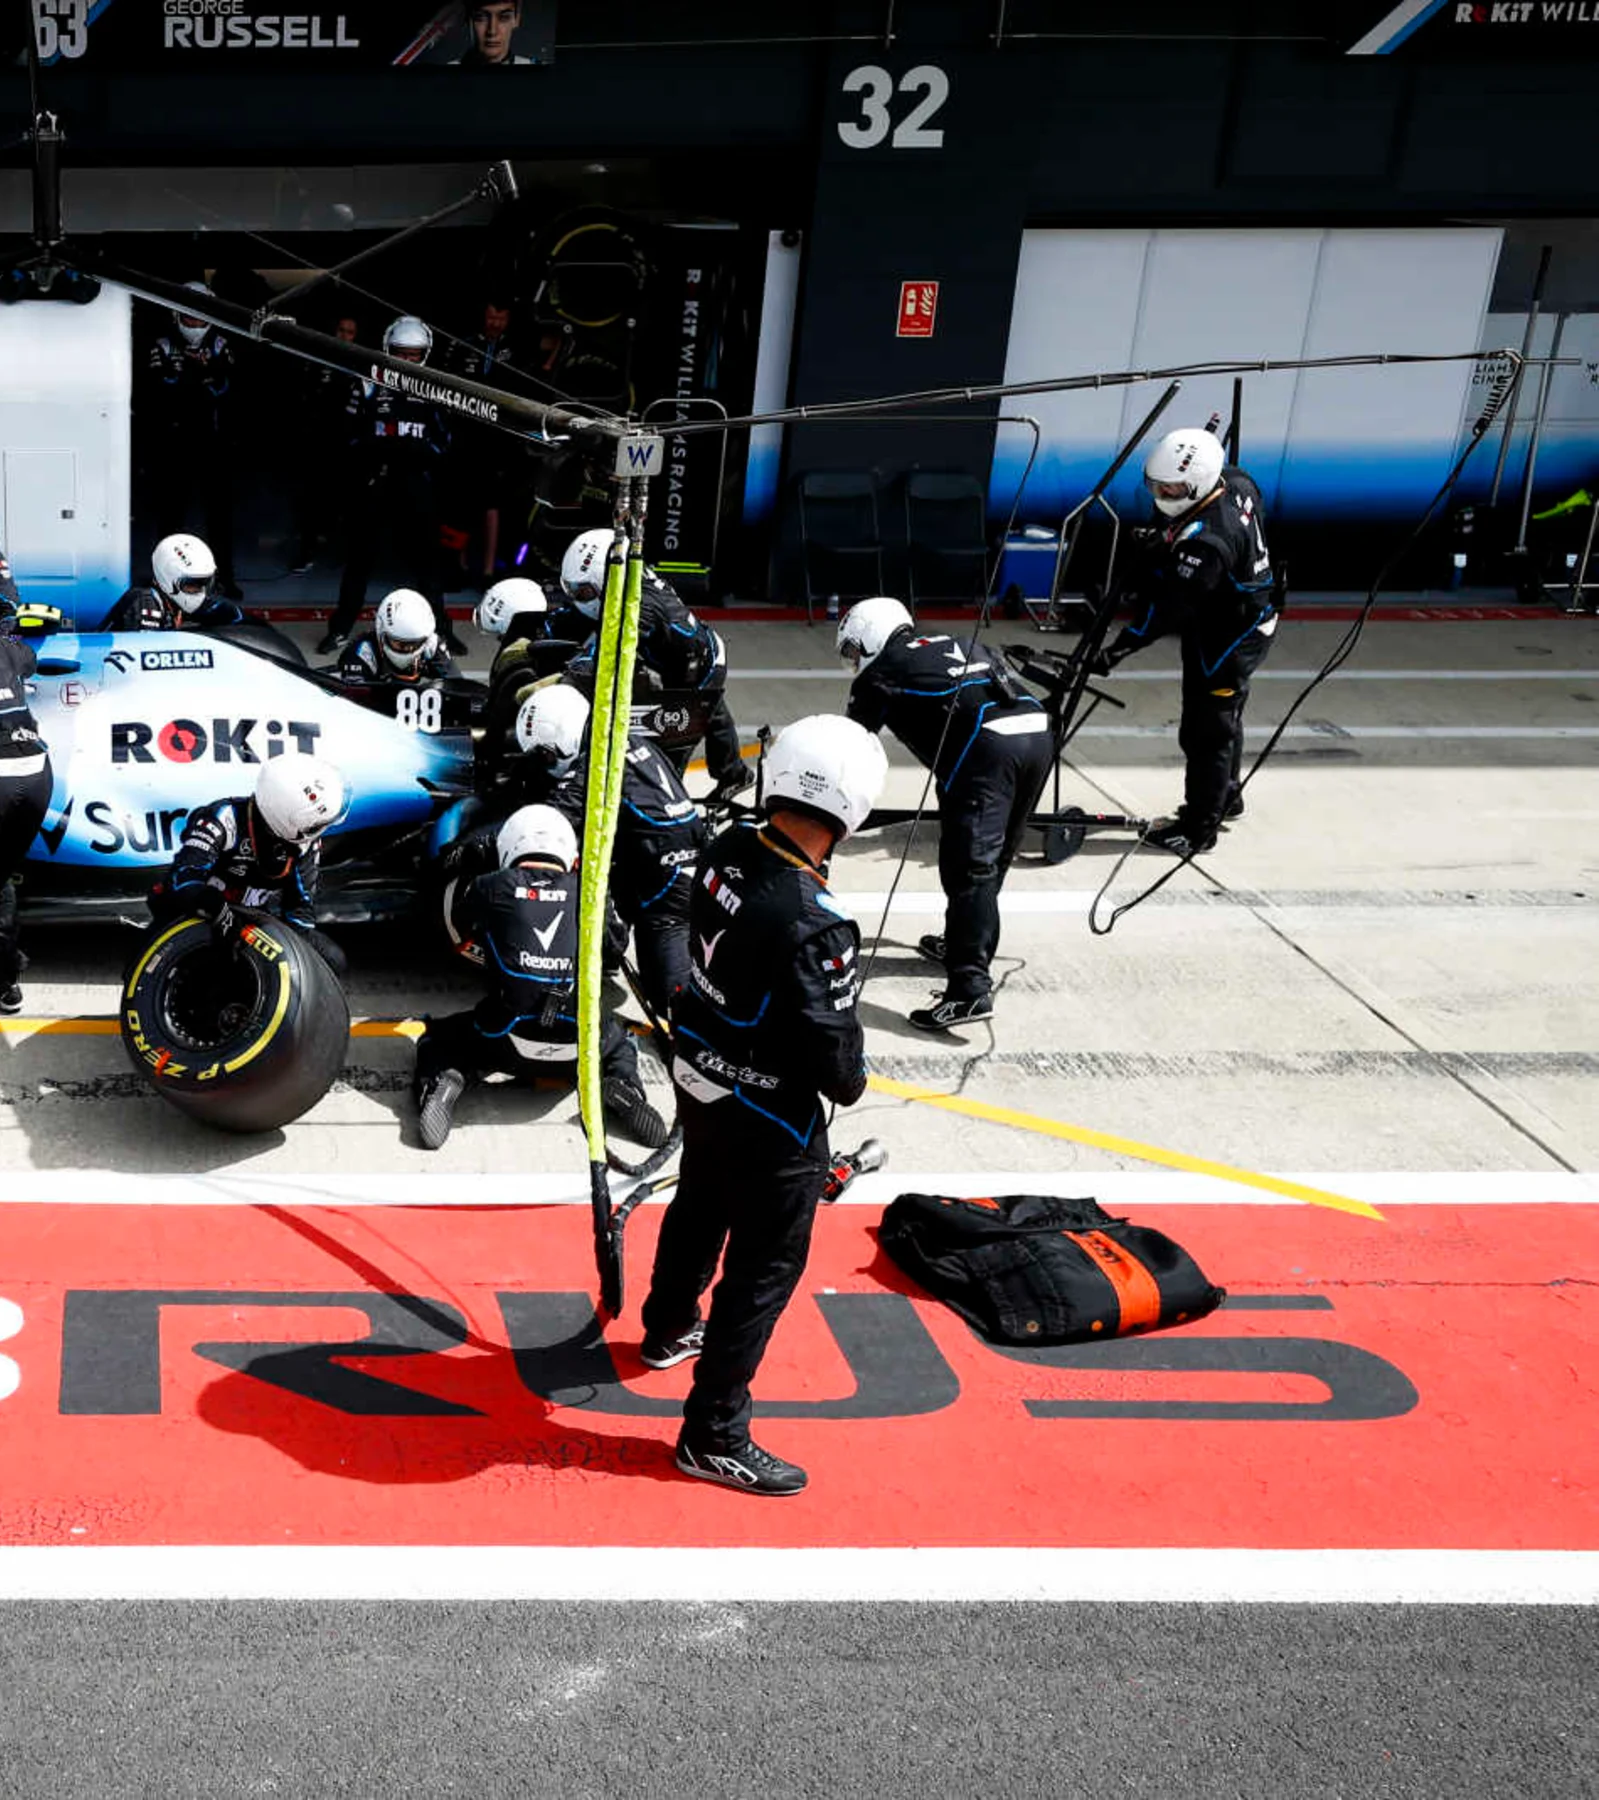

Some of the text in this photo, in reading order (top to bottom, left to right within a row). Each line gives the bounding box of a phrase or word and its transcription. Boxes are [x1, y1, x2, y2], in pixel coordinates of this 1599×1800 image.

[32, 0, 88, 59] 63
[163, 0, 245, 15] GEORGE
[164, 15, 361, 49] RUSSELL
[838, 66, 949, 148] 32
[400, 374, 454, 408] WILLIAMS
[452, 392, 498, 422] RACING
[628, 445, 654, 468] W
[663, 463, 689, 551] RACING
[144, 654, 211, 669] ORLEN
[397, 688, 442, 734] 88
